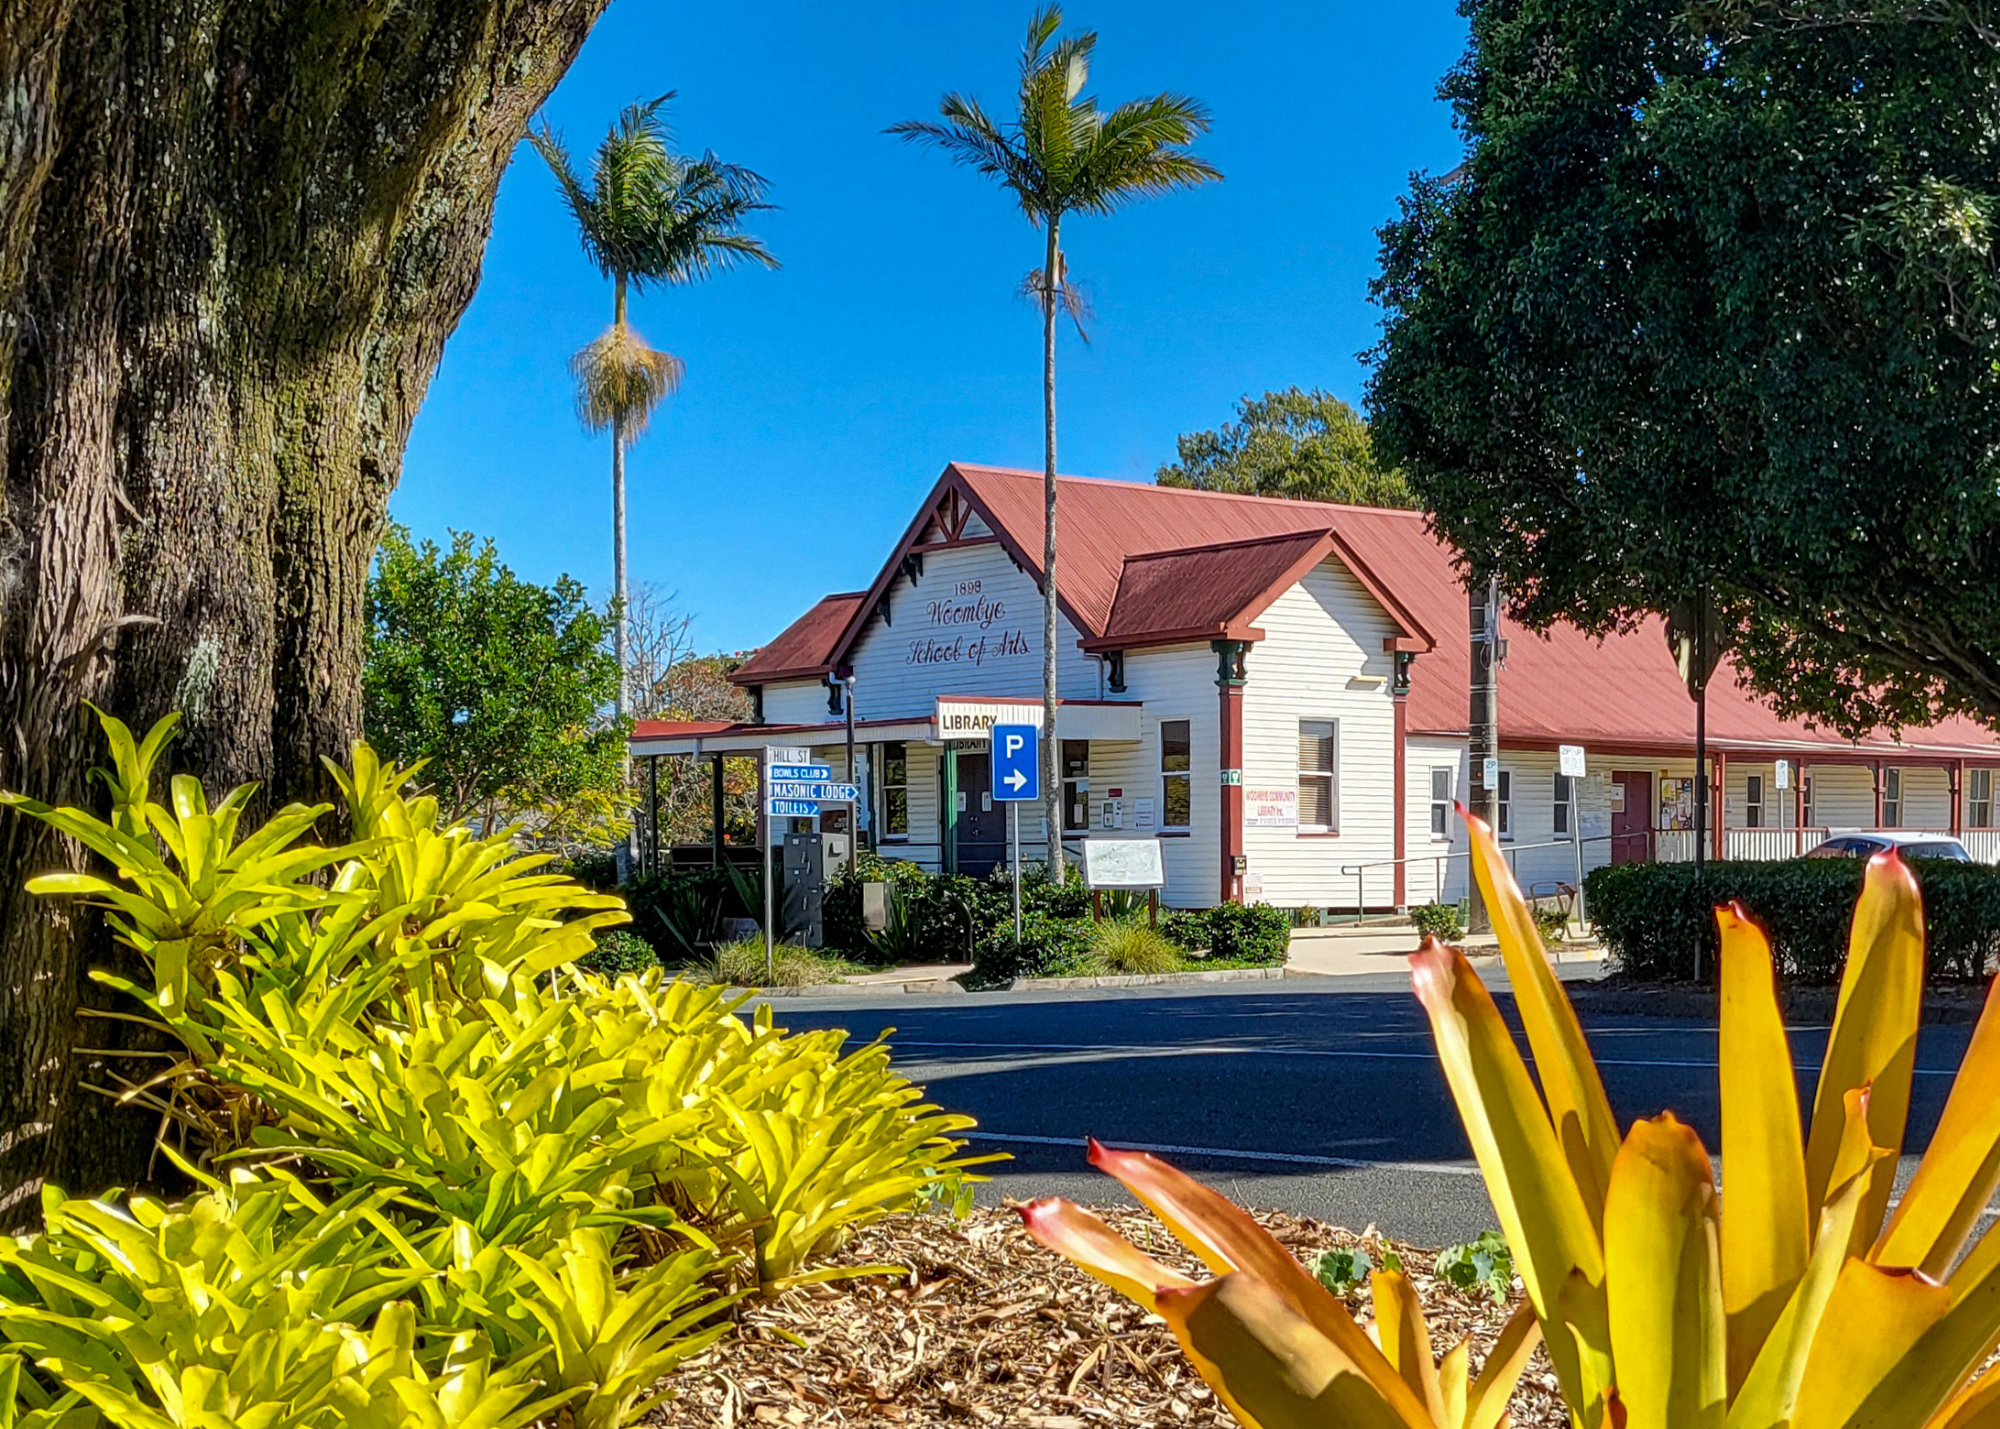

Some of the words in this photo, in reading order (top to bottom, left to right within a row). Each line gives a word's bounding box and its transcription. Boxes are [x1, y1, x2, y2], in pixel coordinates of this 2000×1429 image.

[954, 580, 982, 596] 1898
[926, 595, 1006, 630] Woombye
[906, 635, 963, 665] School
[968, 636, 987, 667] of
[992, 630, 1030, 656] Arts
[942, 715, 998, 731] LIBRARY
[1006, 734, 1024, 759] P
[773, 750, 792, 763] HILL
[797, 750, 807, 763] ST
[1485, 760, 1496, 769] 2P
[773, 768, 799, 779] BOWLS
[800, 768, 821, 779] CLUB
[773, 783, 817, 798] MASONIC
[821, 785, 851, 799] LODGE
[774, 801, 809, 815] TOILETS
